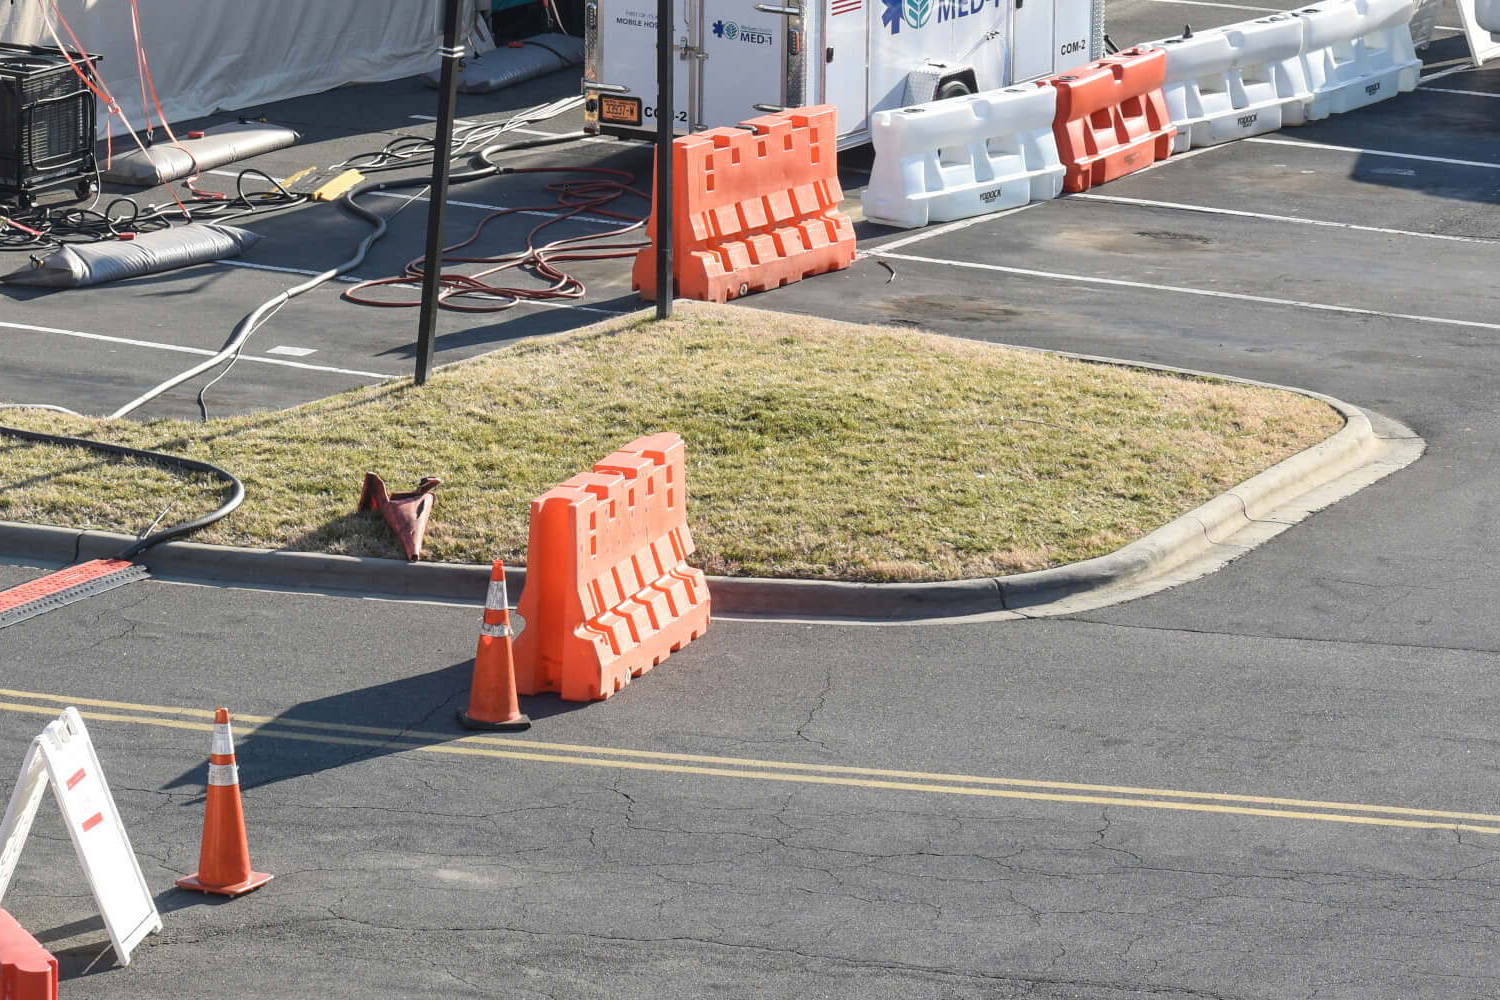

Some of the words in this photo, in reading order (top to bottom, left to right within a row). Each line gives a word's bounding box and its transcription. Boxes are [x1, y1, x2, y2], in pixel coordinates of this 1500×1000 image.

[616, 17, 643, 27] MOBILE
[740, 32, 773, 46] MED-1
[1061, 40, 1086, 56] COM-2
